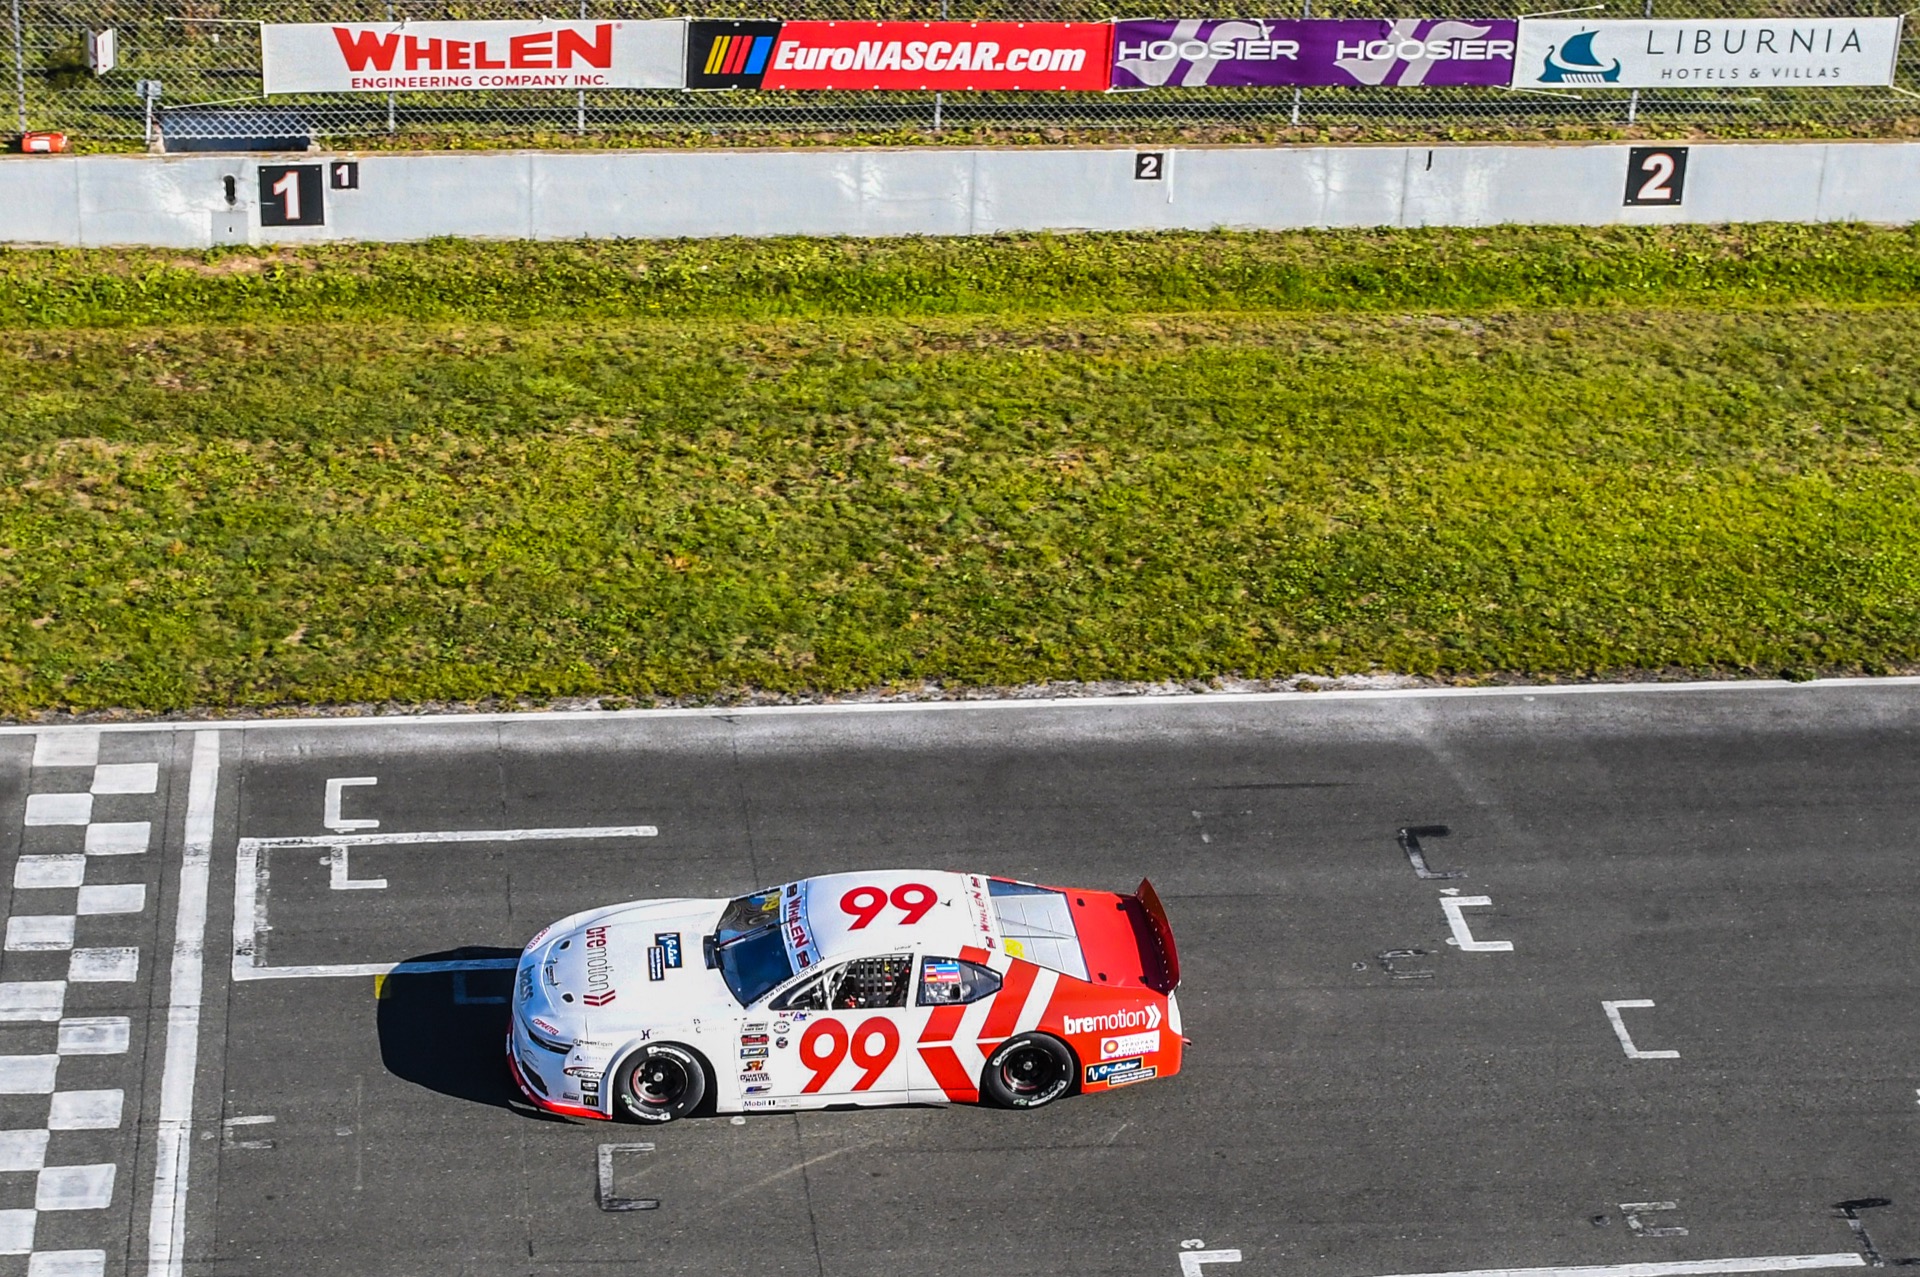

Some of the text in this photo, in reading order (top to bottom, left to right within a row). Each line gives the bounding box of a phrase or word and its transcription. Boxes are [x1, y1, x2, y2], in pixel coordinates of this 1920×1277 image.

[332, 24, 612, 71] WHELEN
[1118, 40, 1300, 61] HOOSIER
[1336, 40, 1513, 61] HOOSIER
[1646, 28, 1862, 55] LIBURNIA
[774, 40, 1086, 72] EuroNASCAR.com
[352, 75, 609, 89] ENGINEERING COMPANY INC.
[1661, 67, 1841, 80] HOTELS & VILLAS
[335, 164, 350, 187] 1
[1140, 156, 1158, 178] 2
[1637, 152, 1675, 200] 2
[272, 170, 301, 220] 1
[840, 883, 938, 931] 99
[1063, 1008, 1146, 1035] bremotion
[799, 1016, 900, 1093] 99
